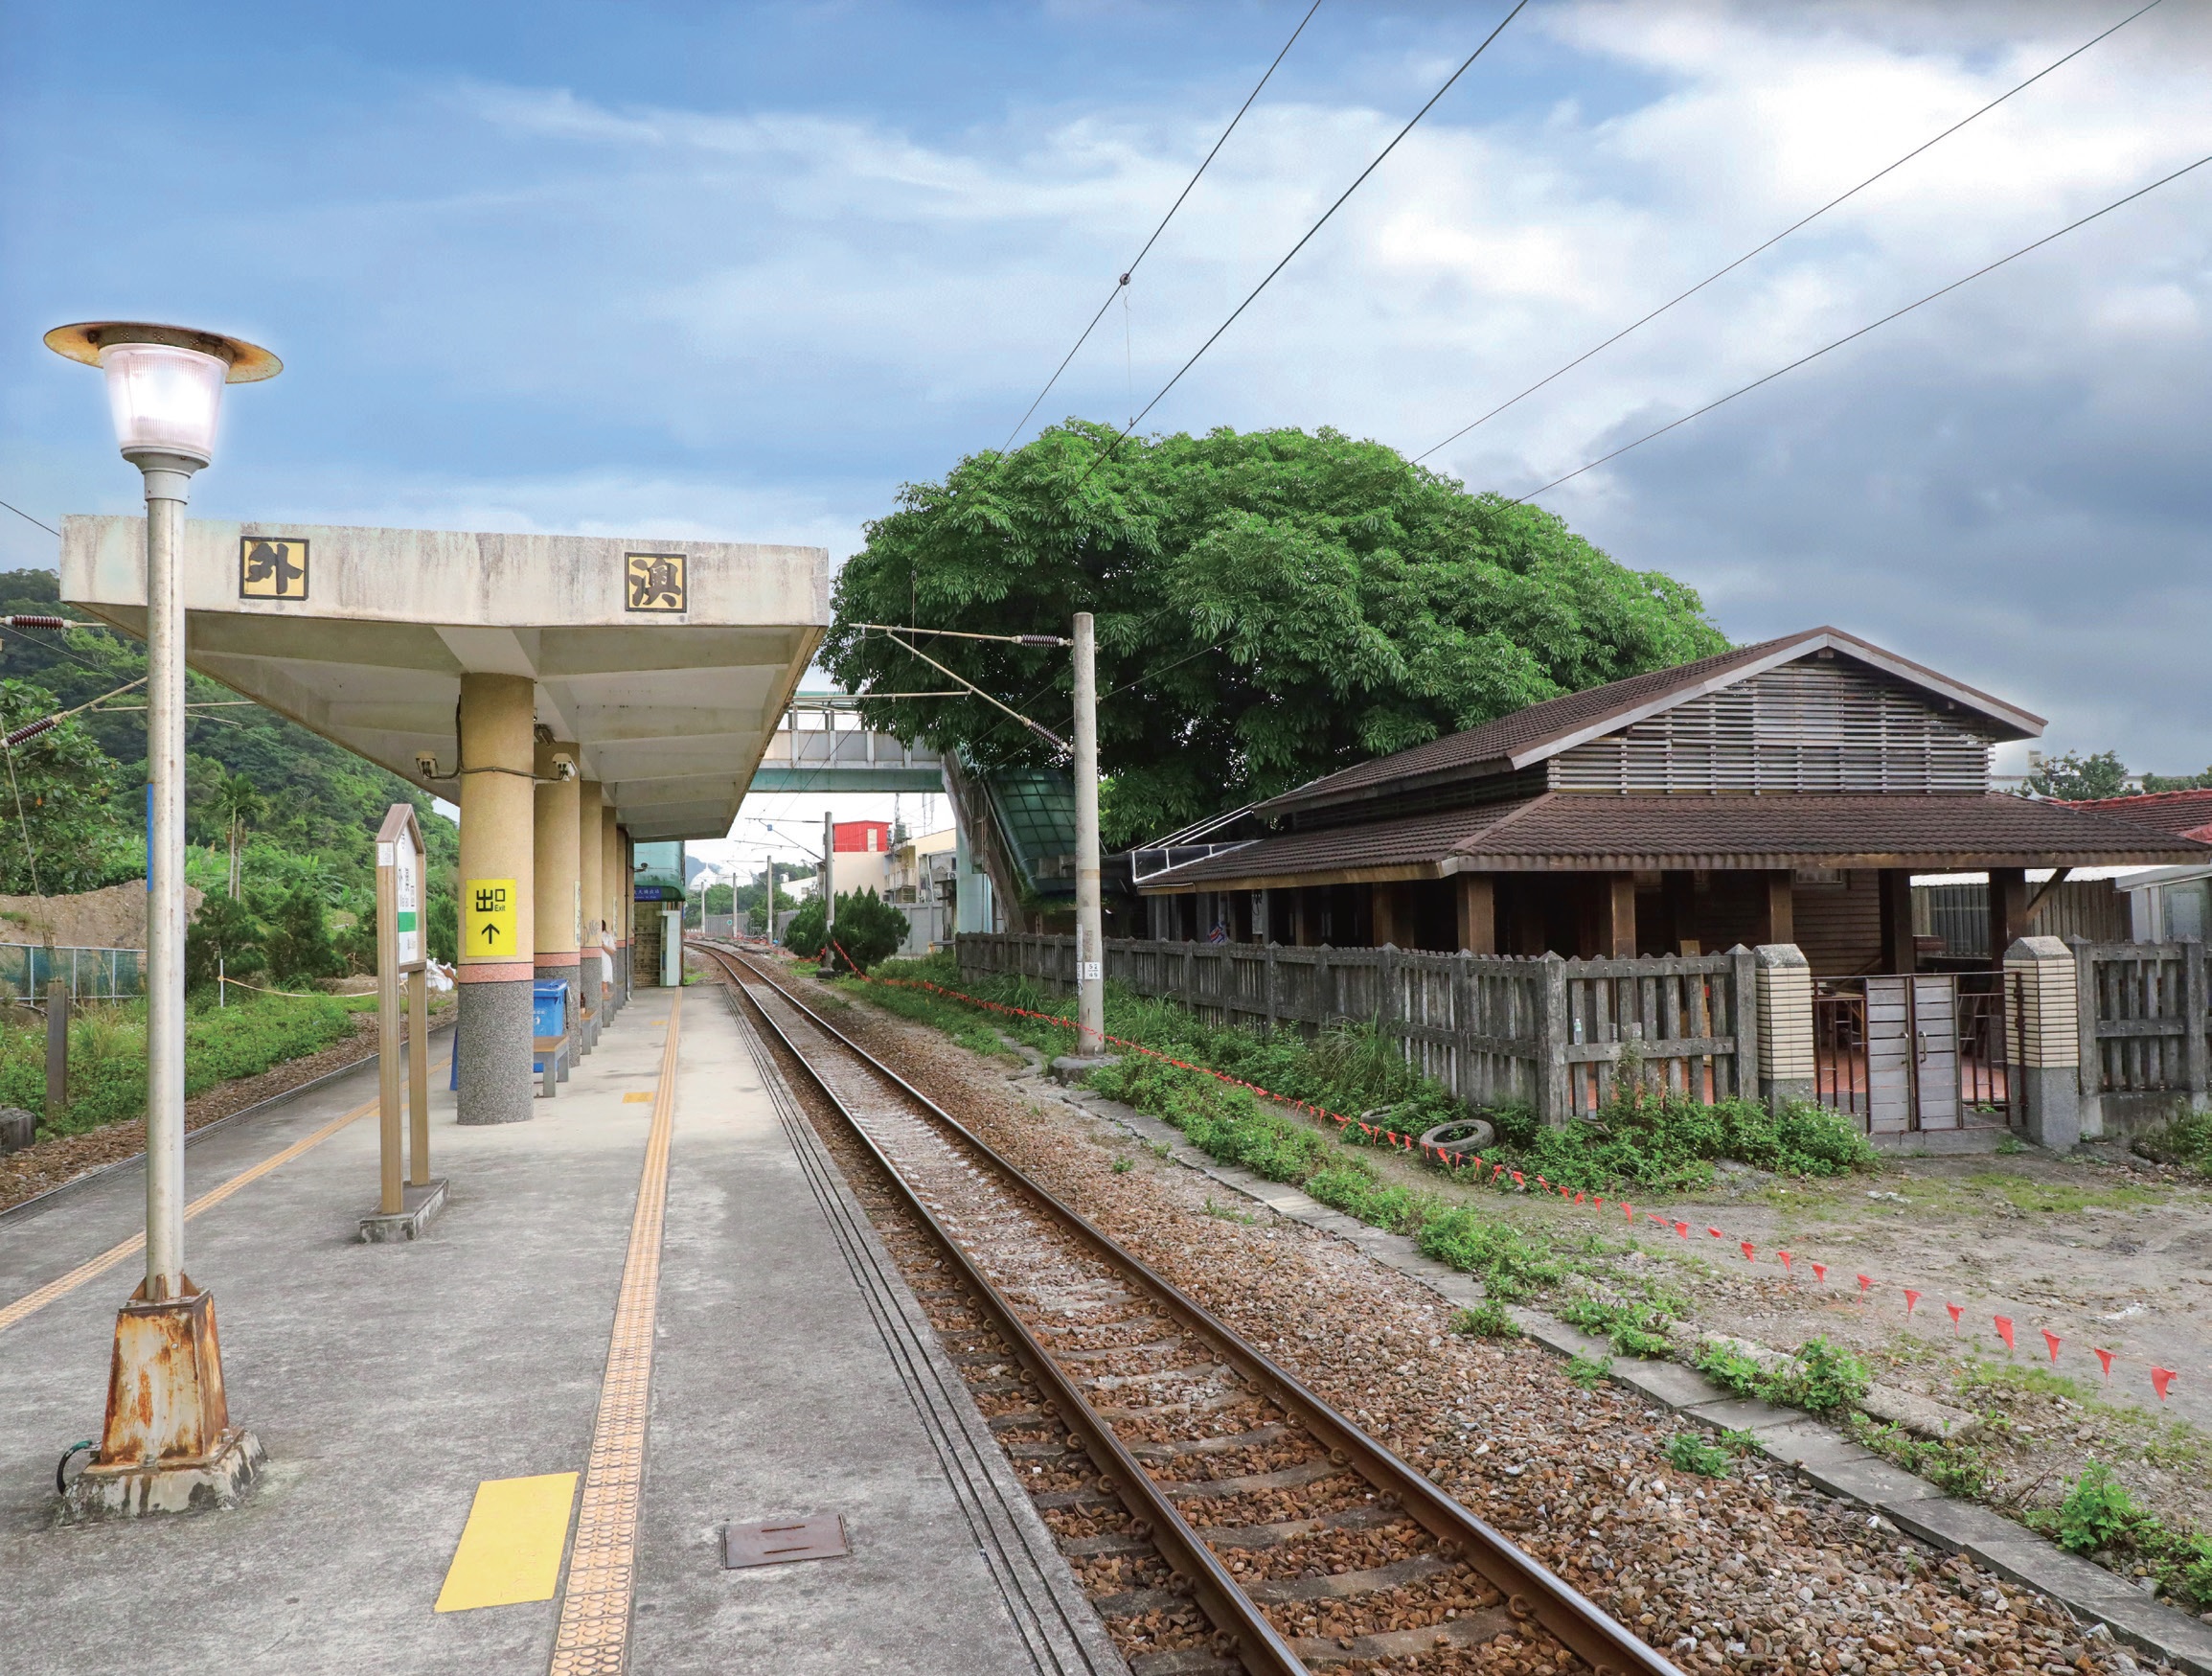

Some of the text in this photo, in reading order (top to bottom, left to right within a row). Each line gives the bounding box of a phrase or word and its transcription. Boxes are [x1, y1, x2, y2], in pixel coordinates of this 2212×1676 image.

[245, 542, 681, 608] 外 澳
[476, 889, 505, 911] 出口
